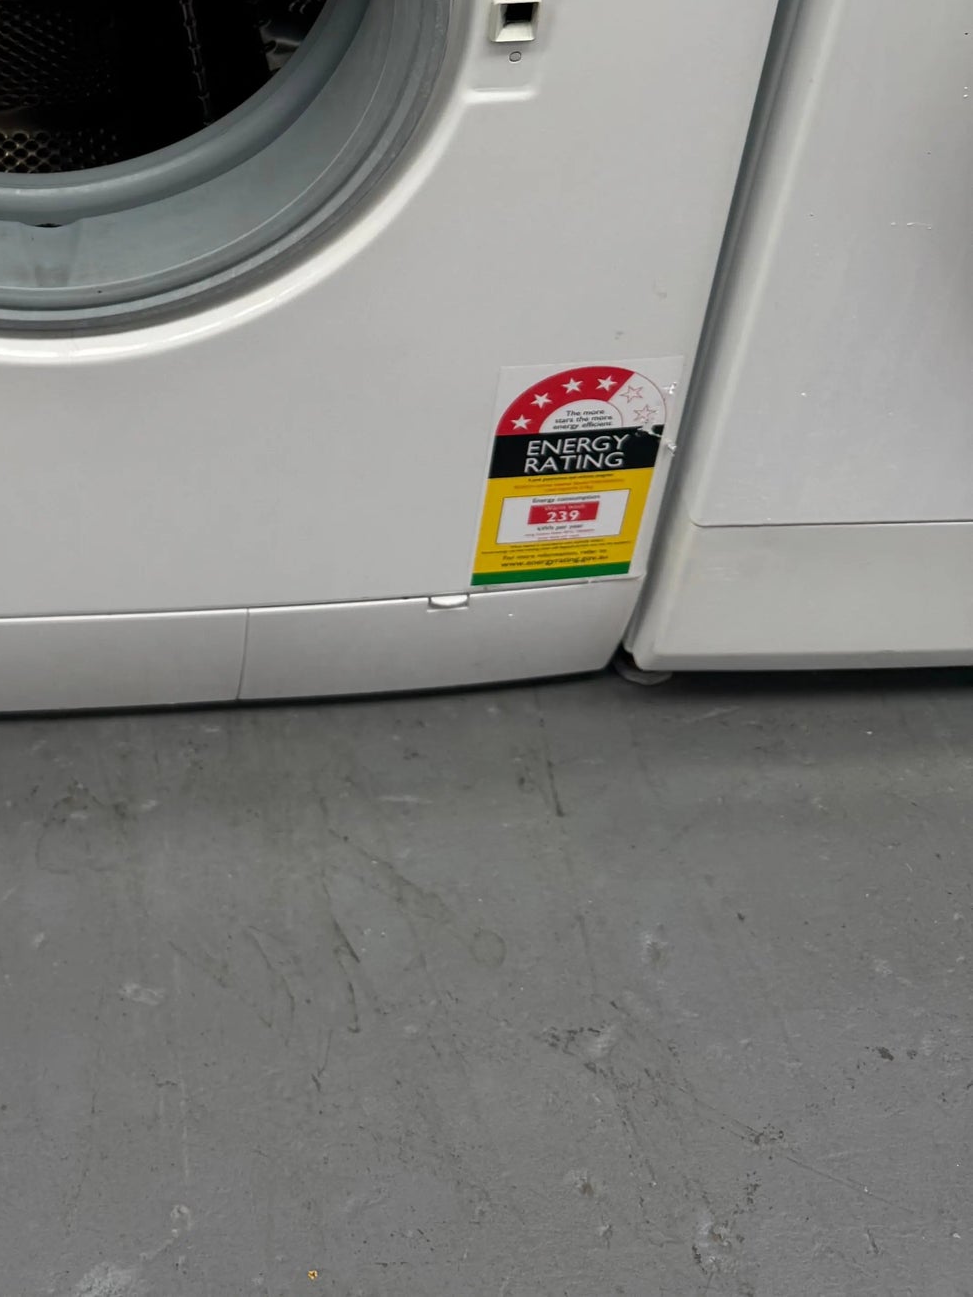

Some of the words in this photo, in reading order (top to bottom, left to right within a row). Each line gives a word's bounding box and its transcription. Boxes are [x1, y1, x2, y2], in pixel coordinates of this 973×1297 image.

[526, 434, 630, 456] ENERGY
[524, 451, 625, 473] RATING
[547, 510, 580, 522] 239
